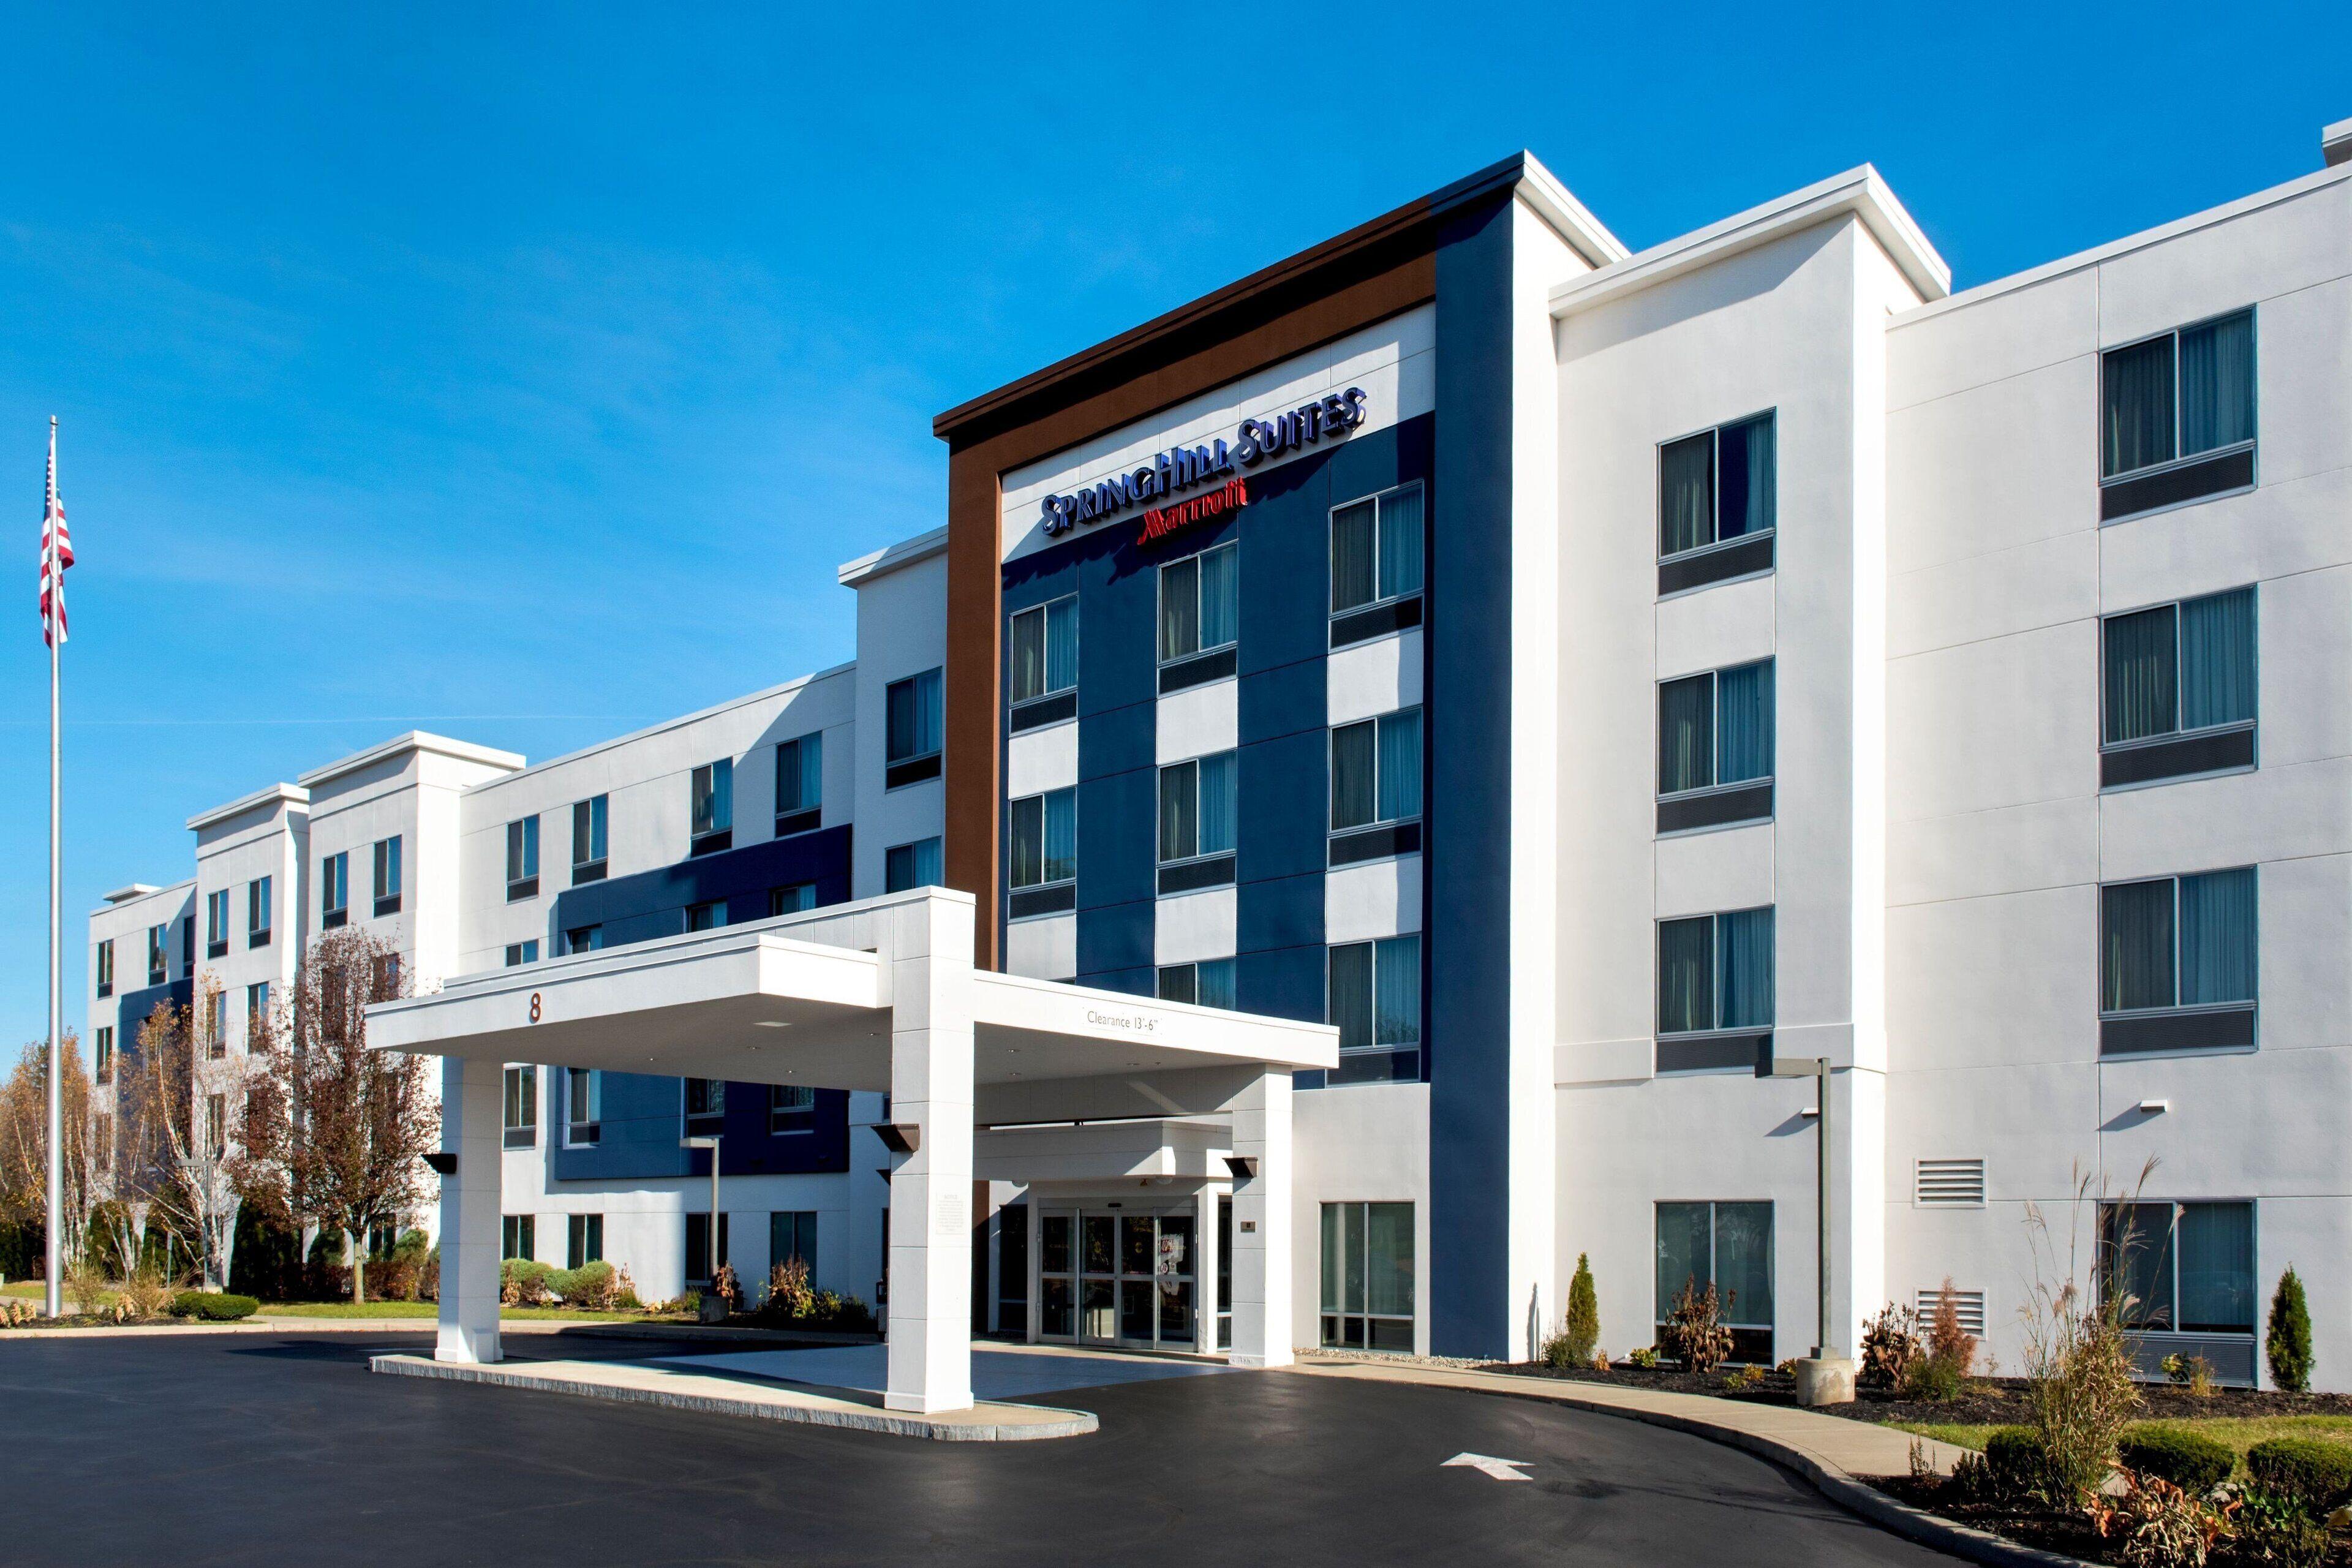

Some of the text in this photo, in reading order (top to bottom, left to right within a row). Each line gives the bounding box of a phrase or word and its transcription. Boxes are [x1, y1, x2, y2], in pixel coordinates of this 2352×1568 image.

[1238, 387, 1367, 467] SUITES
[1137, 476, 1248, 545] Marriott
[530, 992, 541, 1023] 8
[1087, 1011, 1130, 1028] Clearance
